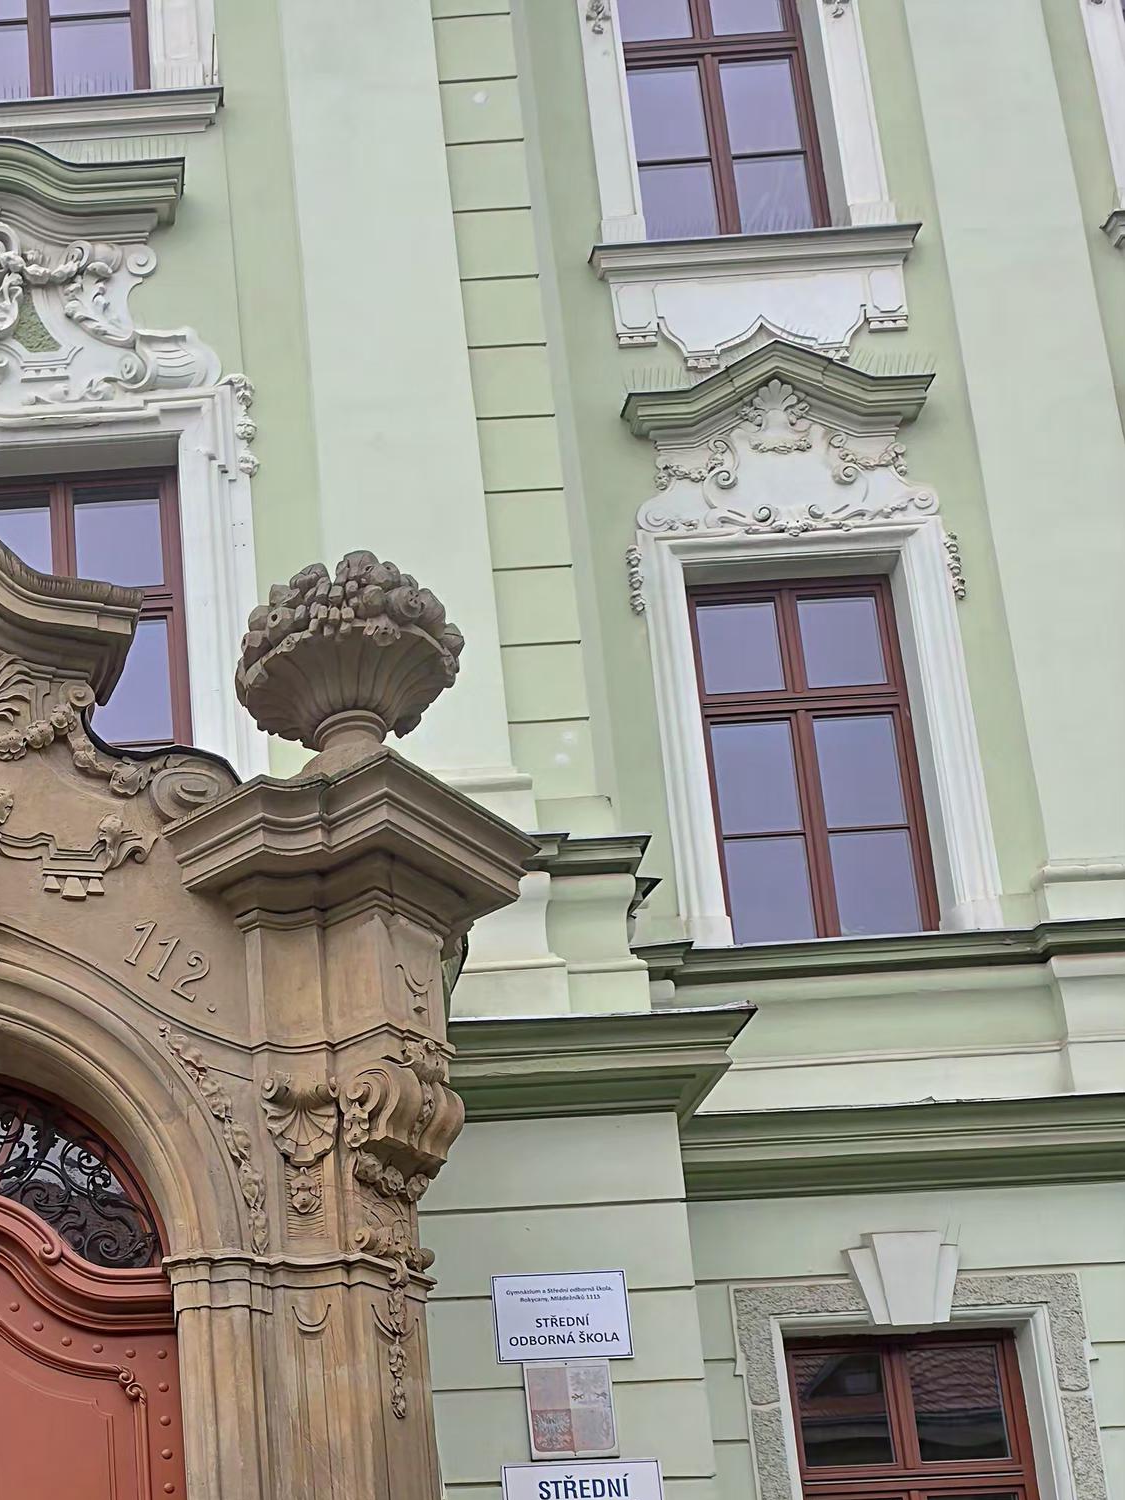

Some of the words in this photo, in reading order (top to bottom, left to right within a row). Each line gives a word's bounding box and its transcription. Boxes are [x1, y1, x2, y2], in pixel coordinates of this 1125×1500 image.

[505, 1288, 541, 1296] Gymnázium
[547, 1286, 568, 1294] Střední
[535, 1313, 590, 1328] STŘEDNÍ
[509, 1331, 576, 1346] ODBORNÁ
[578, 1331, 620, 1344] ŠKOLA
[538, 1473, 629, 1500] STŘEDNÍ
